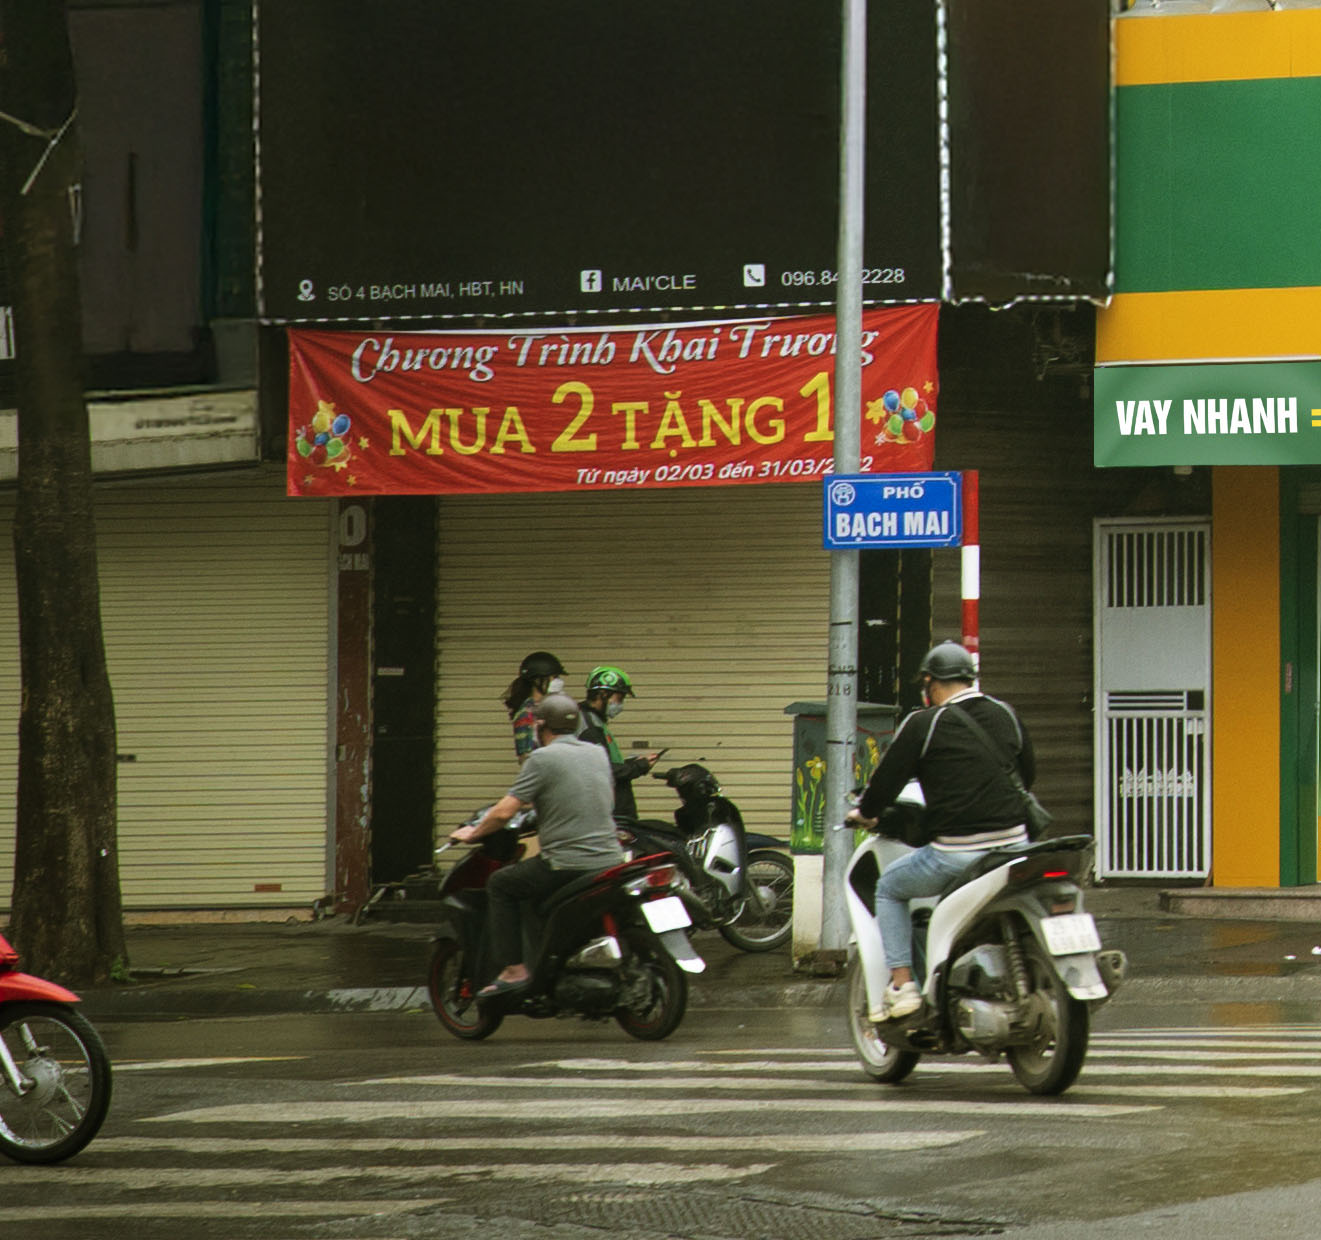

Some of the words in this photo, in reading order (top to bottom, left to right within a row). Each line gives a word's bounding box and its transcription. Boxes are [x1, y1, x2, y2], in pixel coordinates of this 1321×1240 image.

[356, 286, 365, 299] 4
[370, 285, 415, 302] BẠCH
[420, 283, 454, 298] MAI,
[460, 281, 495, 297] HBT,
[501, 281, 523, 296] HN
[612, 274, 696, 292] MAI'CLE
[352, 338, 499, 383] Chương
[508, 332, 616, 367] Trình
[629, 328, 721, 374] Khai
[388, 407, 536, 456] MUA
[552, 381, 597, 452] 2
[612, 390, 785, 458] TẶNG
[800, 371, 834, 442] 1
[1116, 400, 1172, 436] VAY
[1183, 397, 1298, 435] NHANH
[576, 468, 600, 484] Từ
[604, 469, 648, 484] ngày
[654, 466, 714, 482] 02/03
[718, 461, 753, 479] đến
[883, 480, 925, 500] PHỐ
[836, 512, 897, 542] BẠCH
[904, 512, 949, 536] MAI
